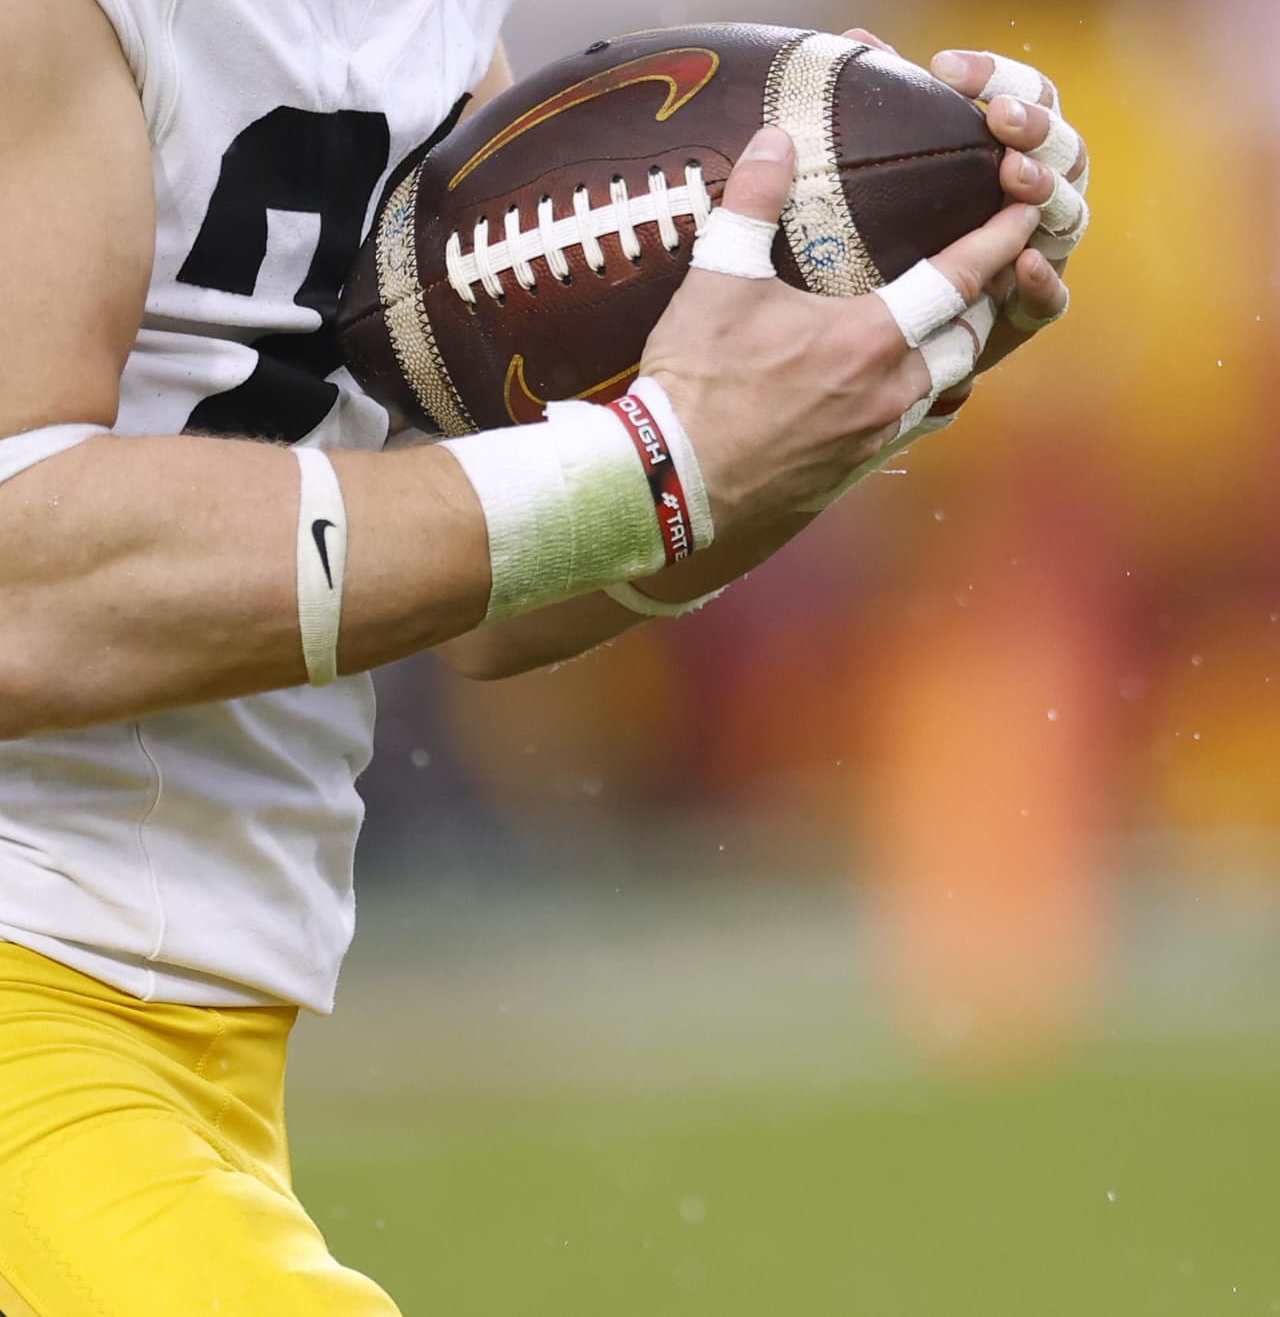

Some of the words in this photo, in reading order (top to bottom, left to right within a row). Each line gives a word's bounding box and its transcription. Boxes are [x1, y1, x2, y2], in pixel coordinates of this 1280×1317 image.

[176, 92, 473, 445] 2
[618, 395, 666, 465] OUGH
[661, 491, 689, 563] #TATE
